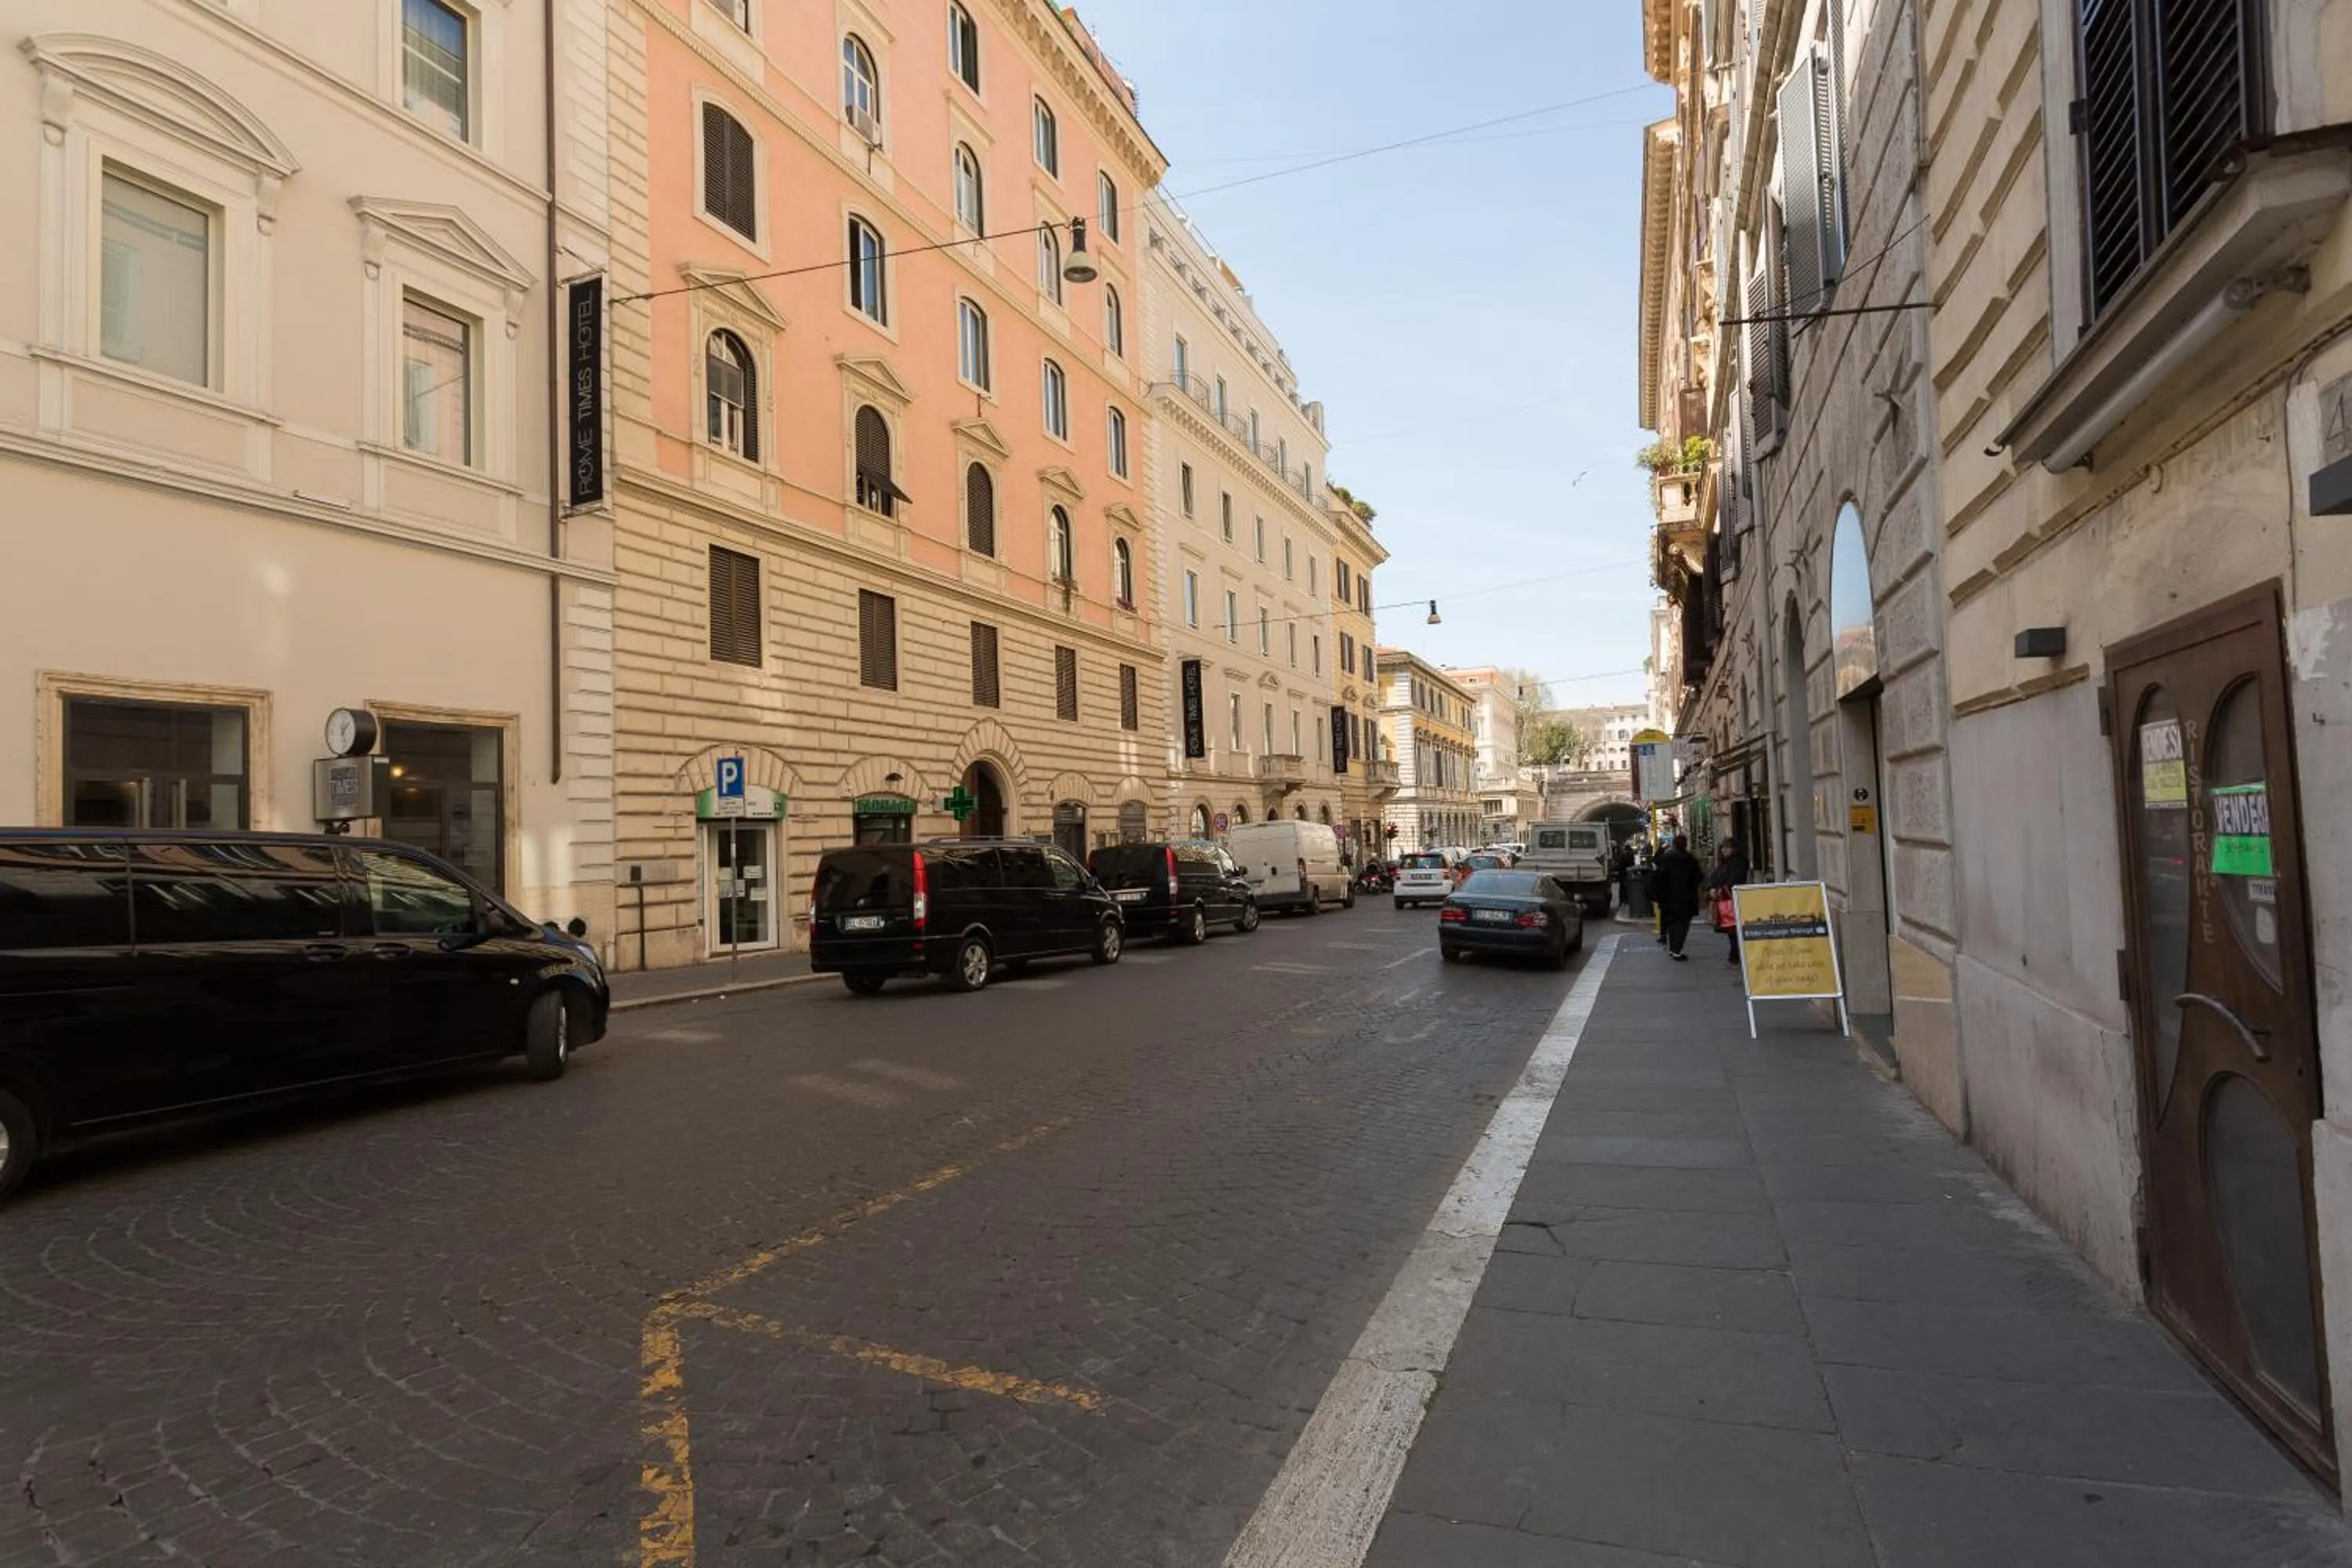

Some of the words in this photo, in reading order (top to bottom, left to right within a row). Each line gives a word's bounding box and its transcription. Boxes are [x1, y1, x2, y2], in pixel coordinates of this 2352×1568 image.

[578, 289, 593, 362] HOTEL
[578, 366, 593, 424] TIMES
[578, 428, 593, 495] ROME
[1186, 665, 1197, 696] HOTEL
[1187, 697, 1198, 722] TIMES
[1189, 724, 1200, 755] ROME
[721, 761, 738, 794] P
[2184, 719, 2216, 944] RISTORANTE
